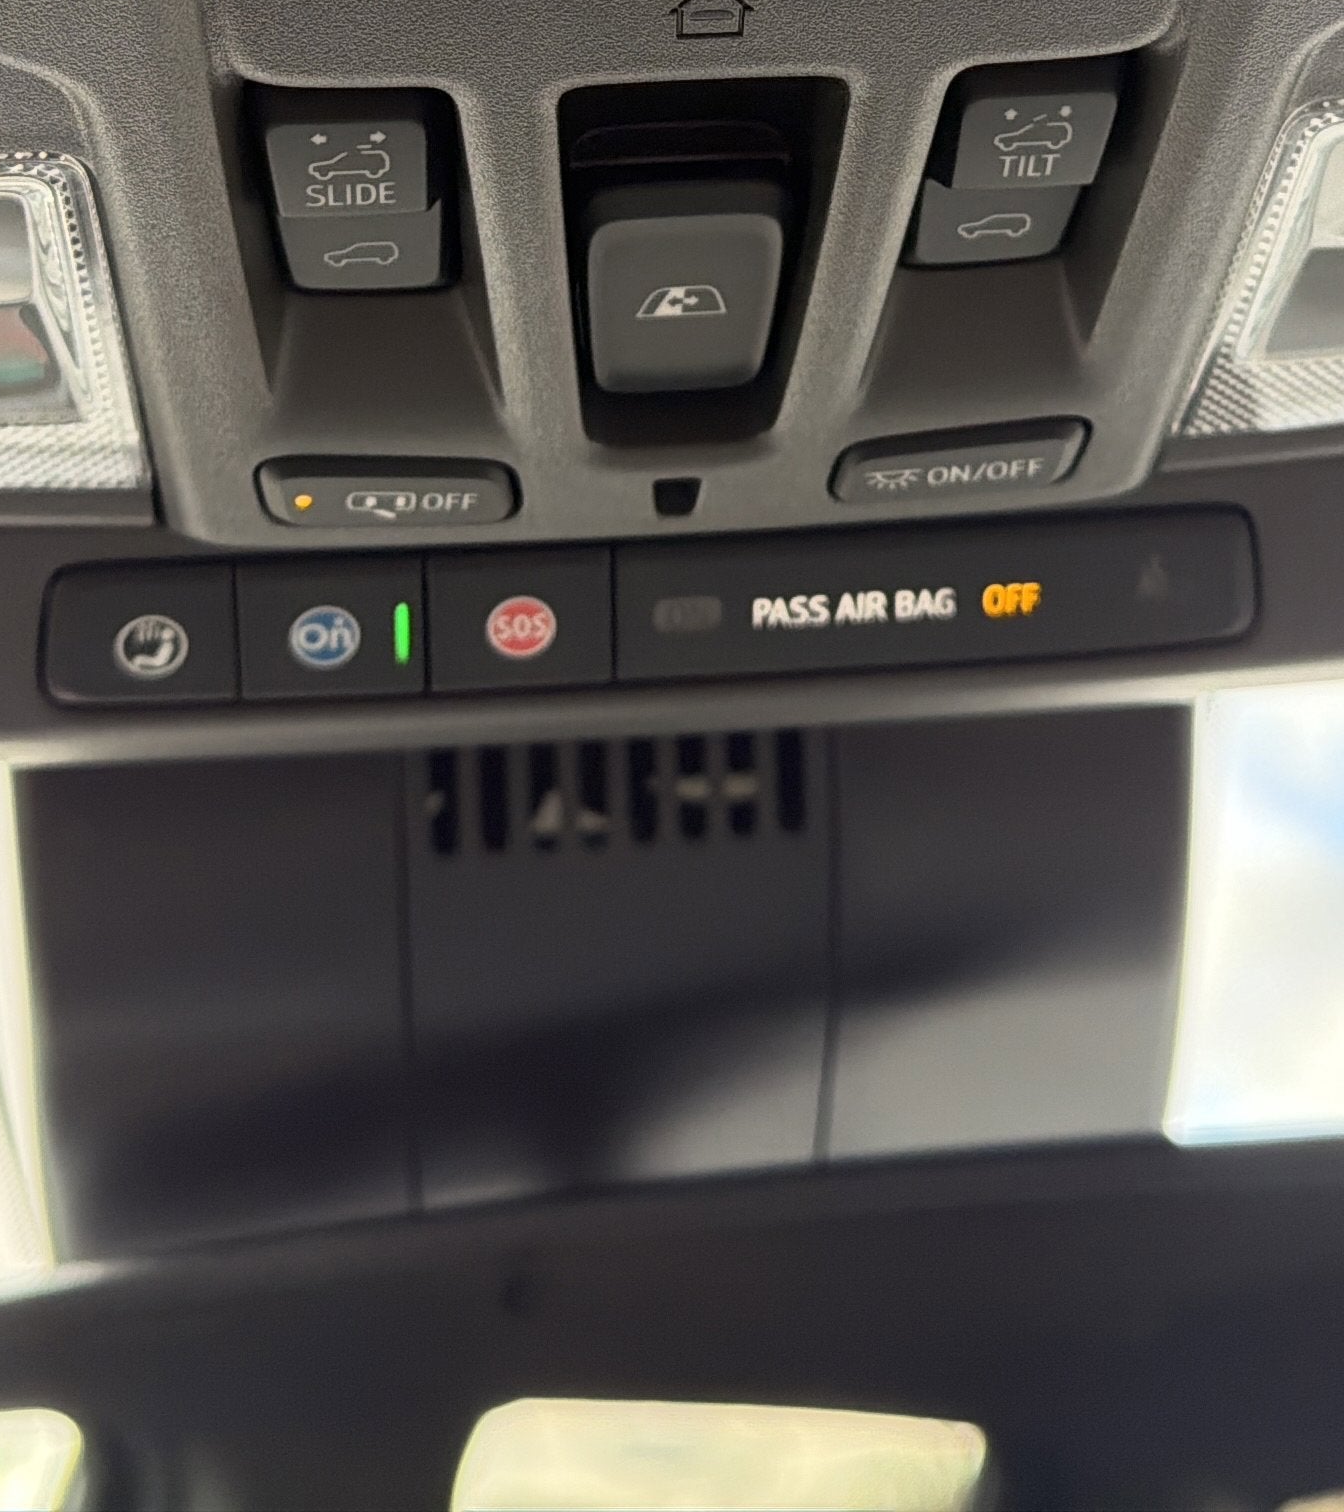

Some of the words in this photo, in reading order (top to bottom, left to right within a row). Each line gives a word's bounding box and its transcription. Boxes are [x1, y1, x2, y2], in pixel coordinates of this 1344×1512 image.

[999, 152, 1061, 178] TILT
[305, 181, 397, 207] SLIDE
[927, 457, 1045, 486] ON/OFF
[421, 491, 478, 511] OFF
[752, 594, 829, 629] PASS
[834, 590, 887, 624] AIR
[893, 587, 957, 620] BAG
[982, 582, 1042, 617] OFF
[492, 612, 548, 640] SOS
